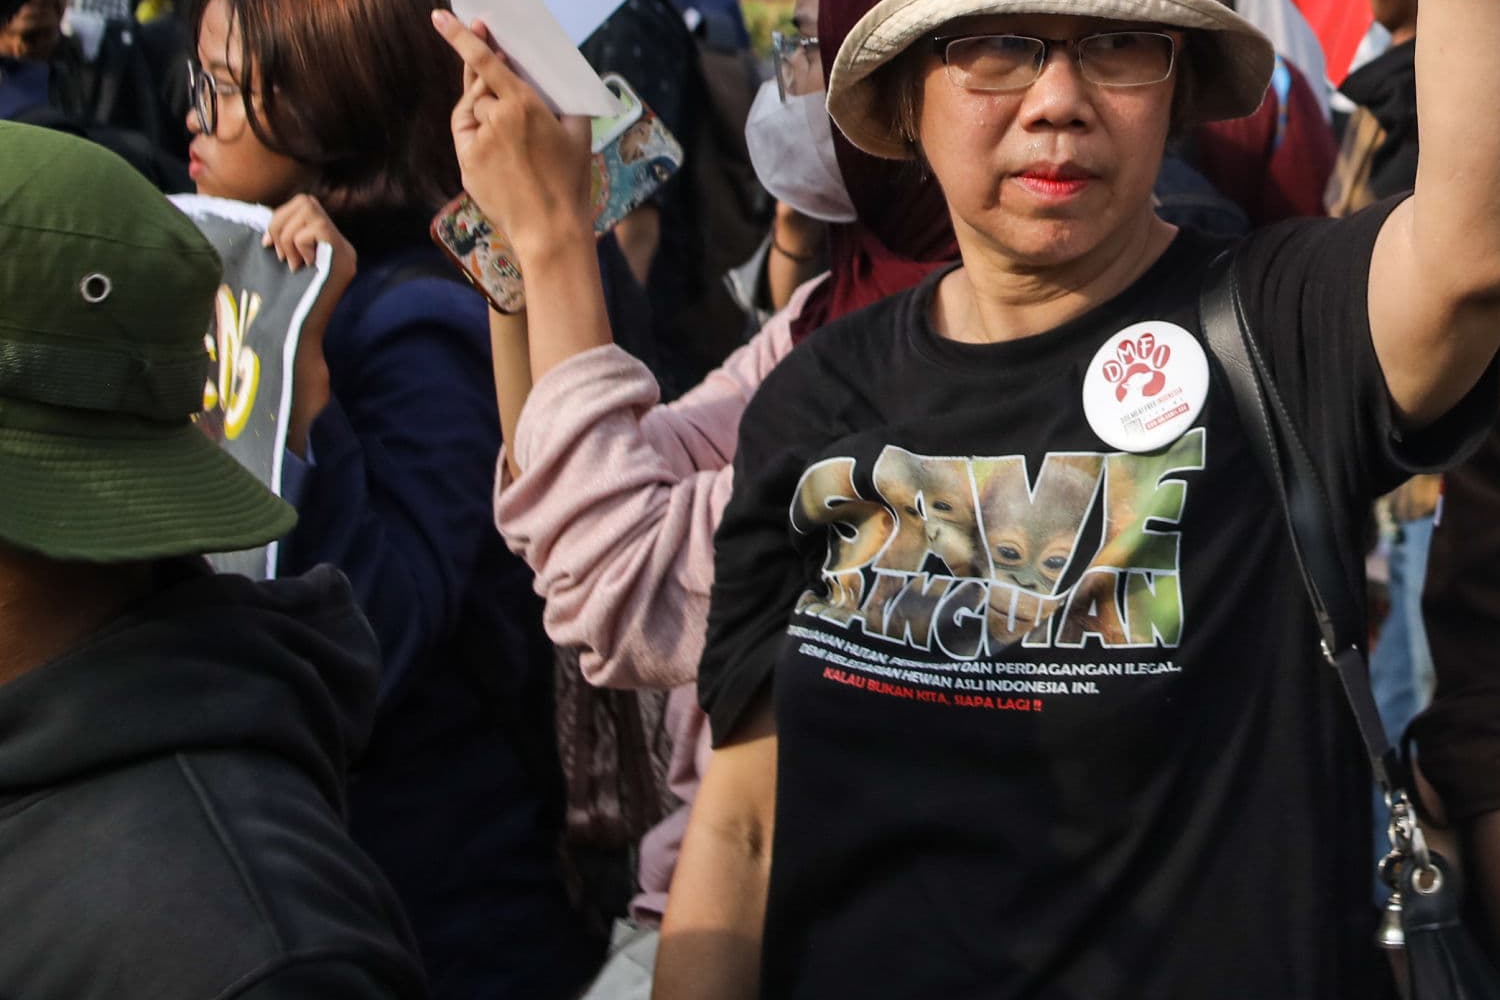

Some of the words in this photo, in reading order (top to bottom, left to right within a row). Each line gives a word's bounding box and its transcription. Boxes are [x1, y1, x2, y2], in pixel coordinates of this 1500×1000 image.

[1103, 336, 1168, 382] DMFI
[790, 427, 1206, 599] SAVE
[823, 666, 866, 689] KALAU
[867, 678, 914, 699] BUKAN
[953, 694, 994, 709] SIAPA
[997, 697, 1031, 711] LAGI
[901, 669, 952, 690] HEWAN
[954, 677, 984, 692] ASLI
[986, 679, 1069, 694] INDONESIA
[1071, 681, 1100, 695] INI.
[960, 661, 993, 675] DAN
[995, 662, 1122, 676] PERDAGANGAN
[1124, 661, 1183, 676] ILEGAL.
